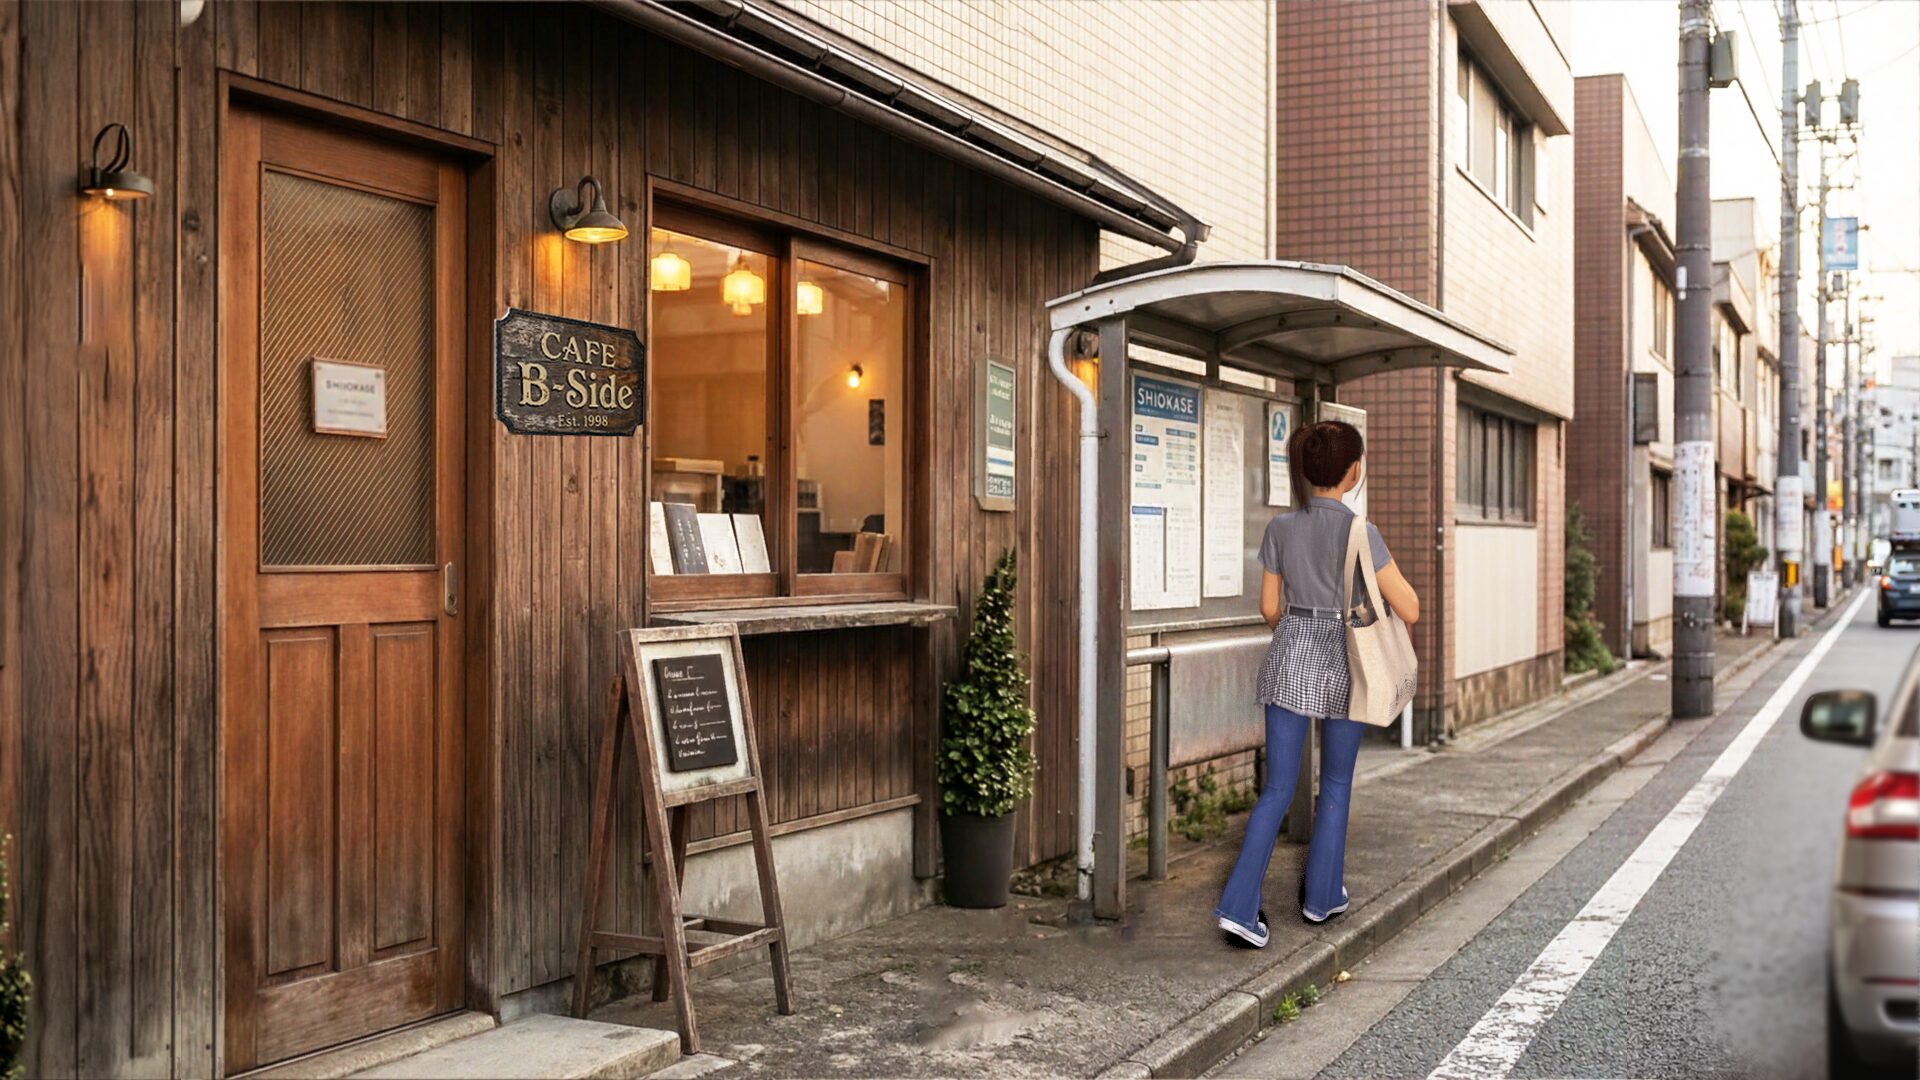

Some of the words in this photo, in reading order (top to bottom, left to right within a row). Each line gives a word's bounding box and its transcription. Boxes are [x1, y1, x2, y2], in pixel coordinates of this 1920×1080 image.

[541, 332, 616, 368] CAFE
[517, 361, 634, 409] B-Side
[1137, 387, 1193, 414] SHIOKASE
[557, 414, 580, 427] Est.
[584, 414, 608, 427] 1998
